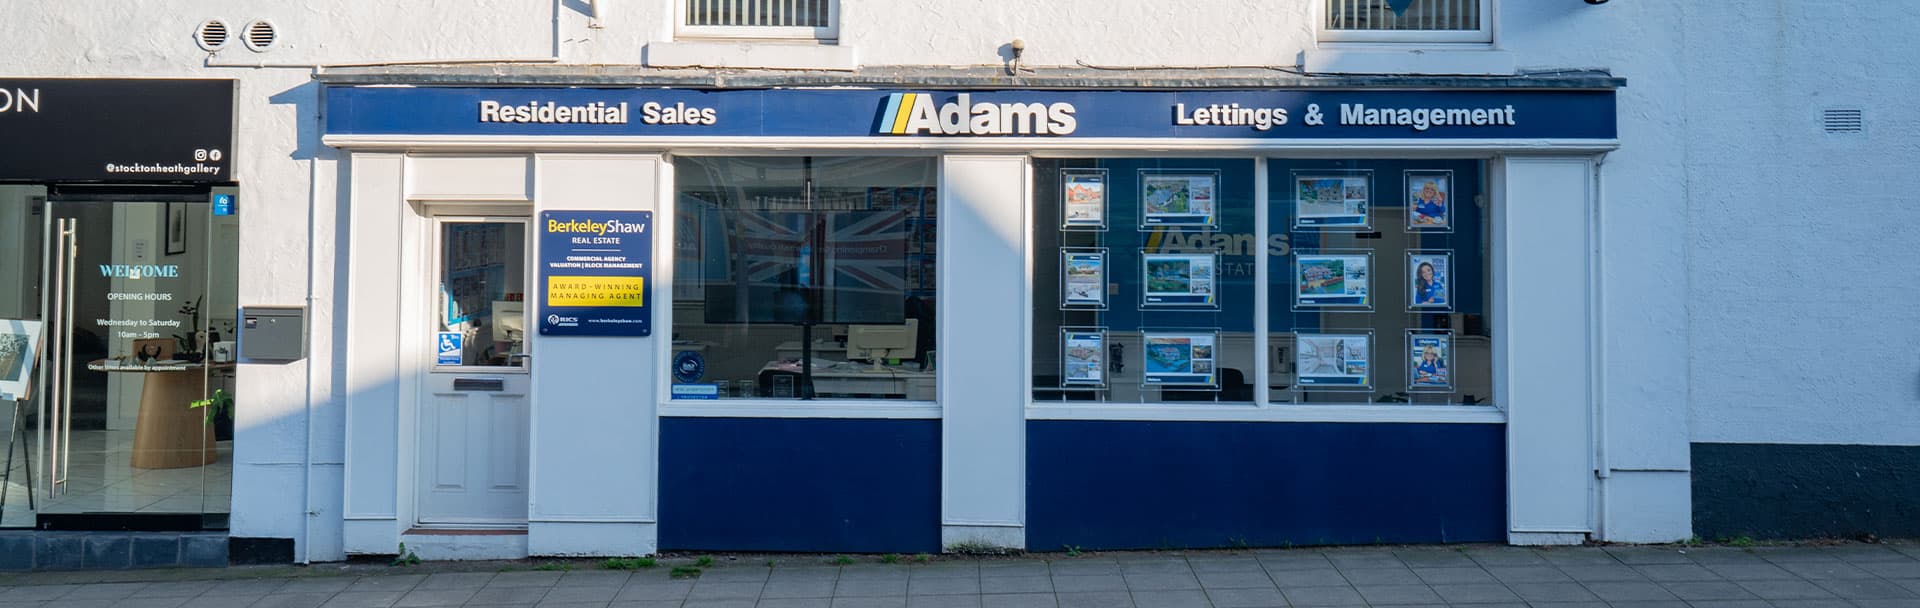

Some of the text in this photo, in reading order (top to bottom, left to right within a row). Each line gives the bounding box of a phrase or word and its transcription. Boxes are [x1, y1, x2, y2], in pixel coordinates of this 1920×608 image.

[480, 101, 717, 125] Residential Sales
[904, 93, 1077, 135] Adams
[1177, 103, 1516, 131] Lettings & Management
[106, 163, 220, 175] @stocktonheathgallery
[548, 219, 645, 236] BerkeleyShaw
[107, 292, 172, 301] OPENING HOURS
[96, 318, 138, 328] Wednesday
[148, 319, 181, 328] Saturday
[143, 331, 160, 340] 5pm
